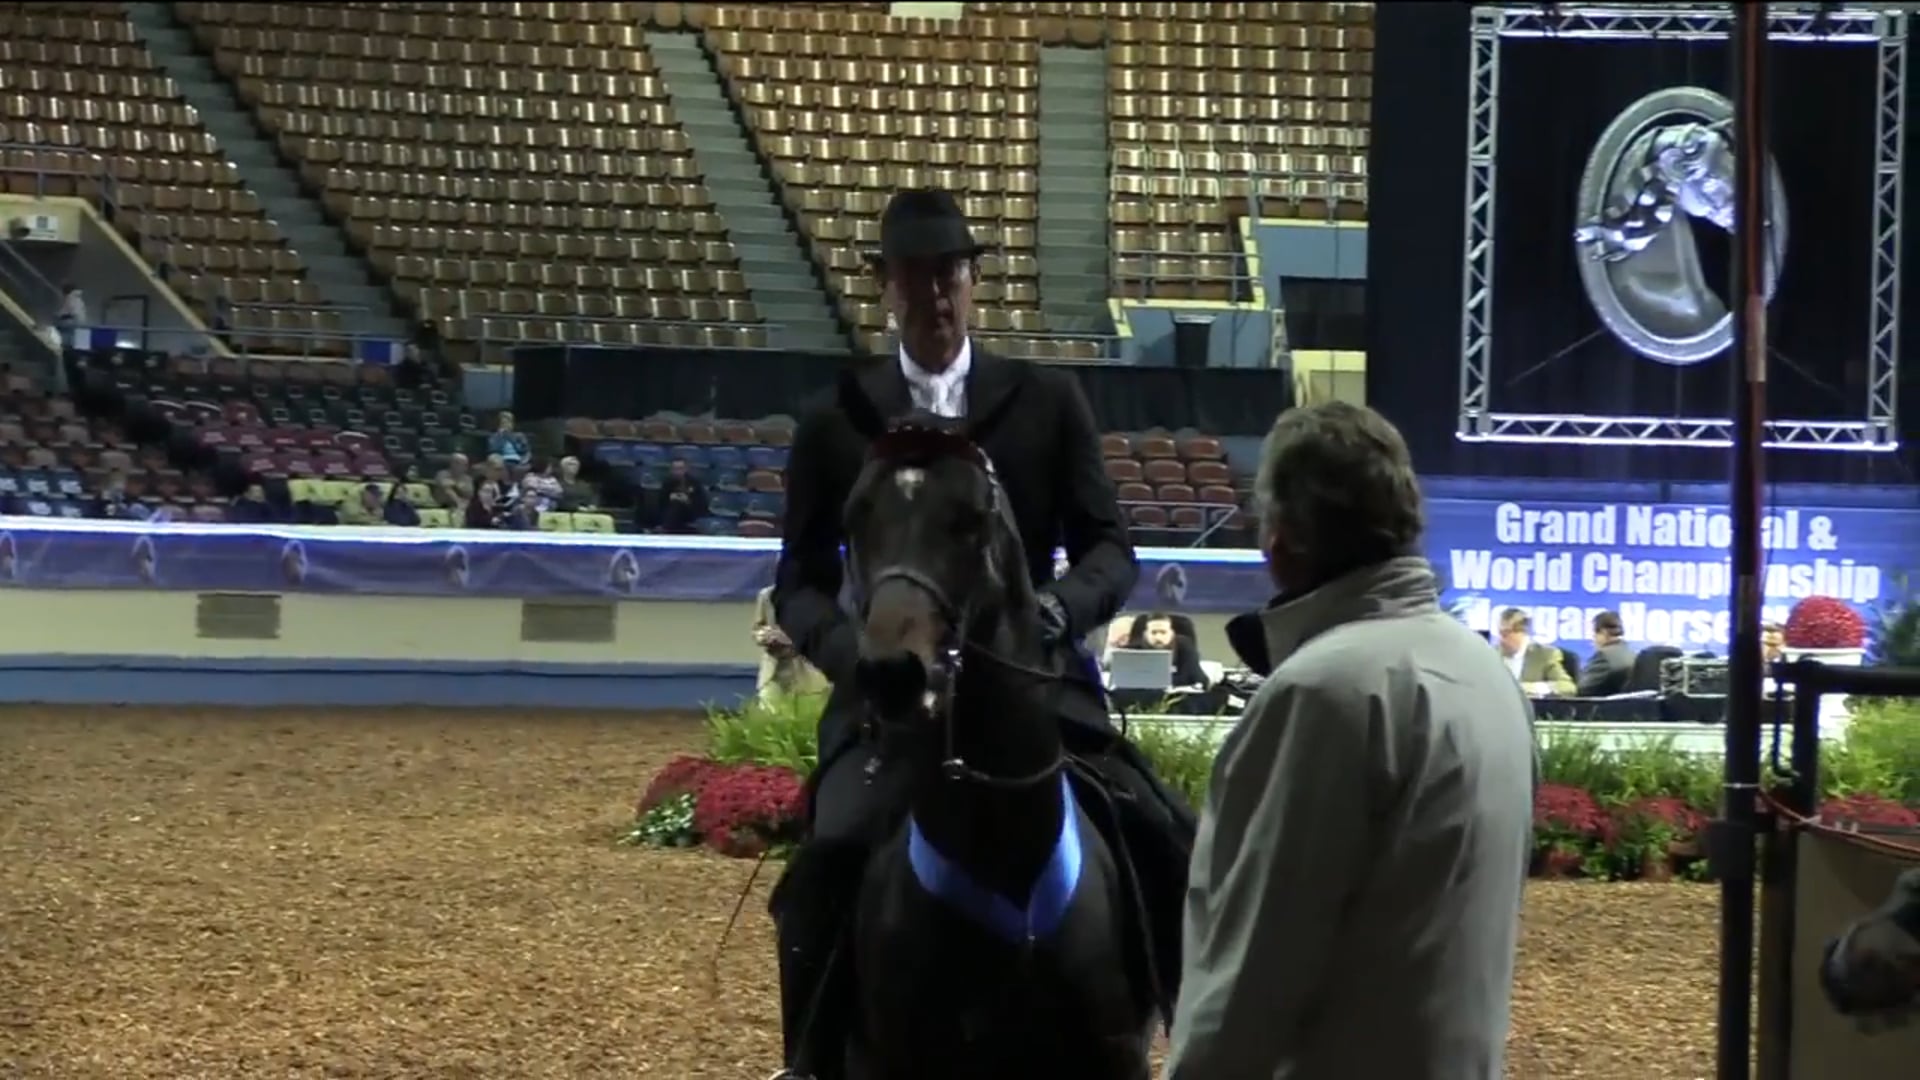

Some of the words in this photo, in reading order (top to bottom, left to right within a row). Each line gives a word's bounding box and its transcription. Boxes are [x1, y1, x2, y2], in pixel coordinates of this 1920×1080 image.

[1496, 502, 1616, 545] Grand
[1627, 506, 1799, 549] Natioal
[1807, 515, 1838, 550] &
[1450, 549, 1572, 592] World
[1582, 552, 1880, 602] Champinship
